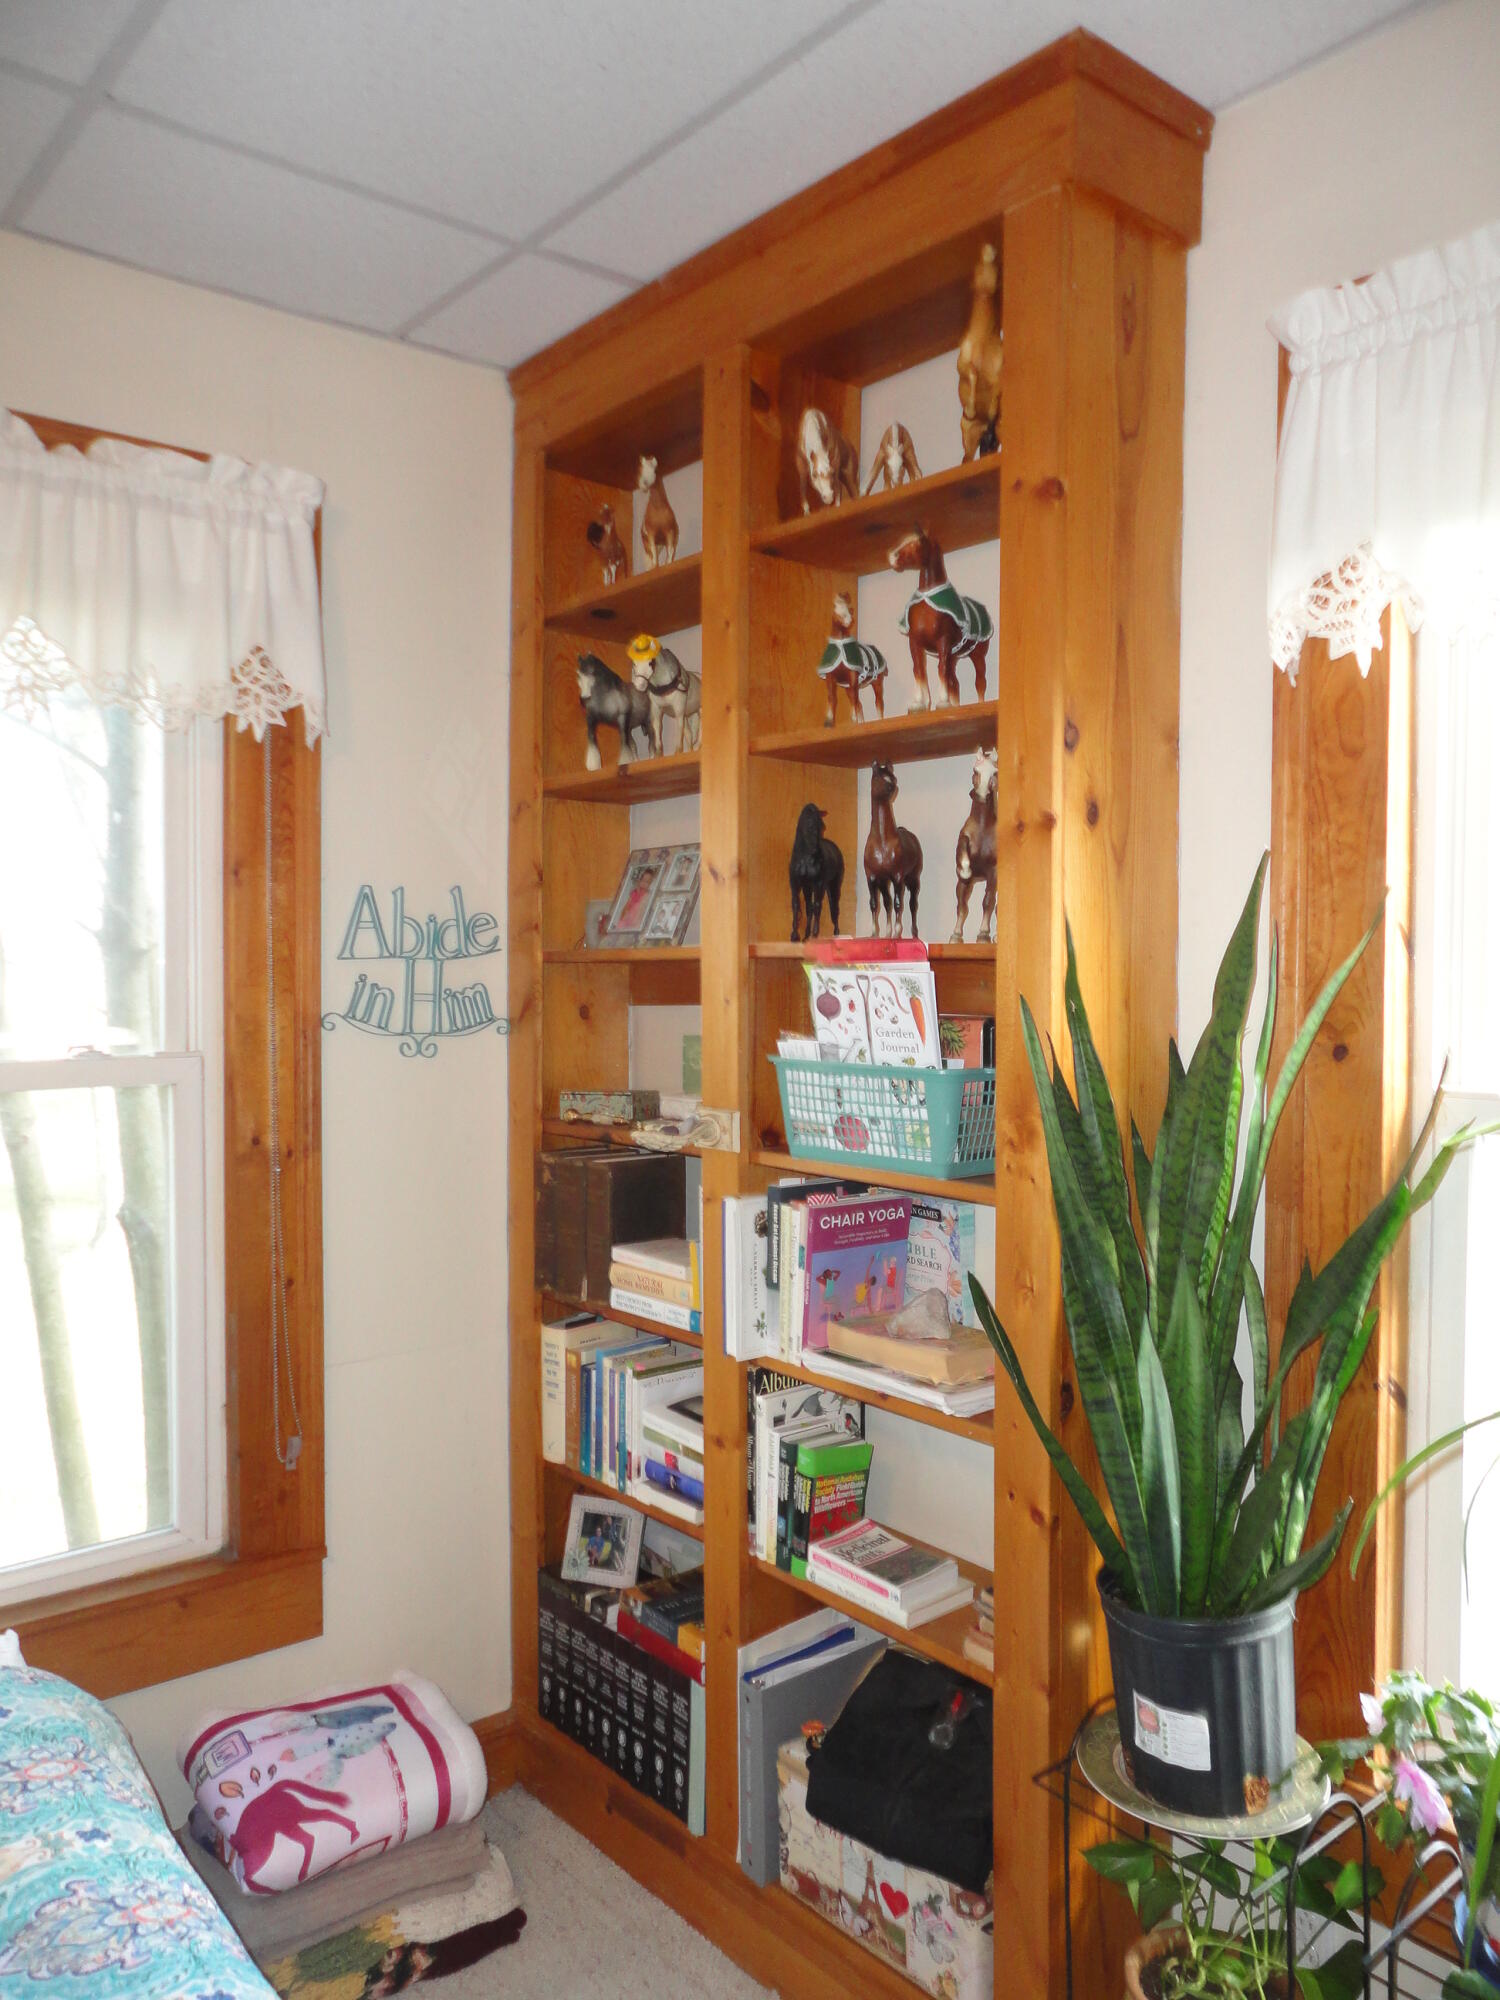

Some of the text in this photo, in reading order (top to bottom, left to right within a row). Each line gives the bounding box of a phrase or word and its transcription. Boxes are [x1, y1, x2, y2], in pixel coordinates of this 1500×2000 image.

[337, 885, 500, 959] Abide
[344, 959, 495, 1034] in Him
[875, 1027, 915, 1040] Garden
[881, 1041, 920, 1054] Journal
[820, 1212, 865, 1230] CHAIR
[868, 1207, 905, 1223] YOGA
[908, 1242, 937, 1260] IBLE
[917, 1258, 942, 1272] SEARCH
